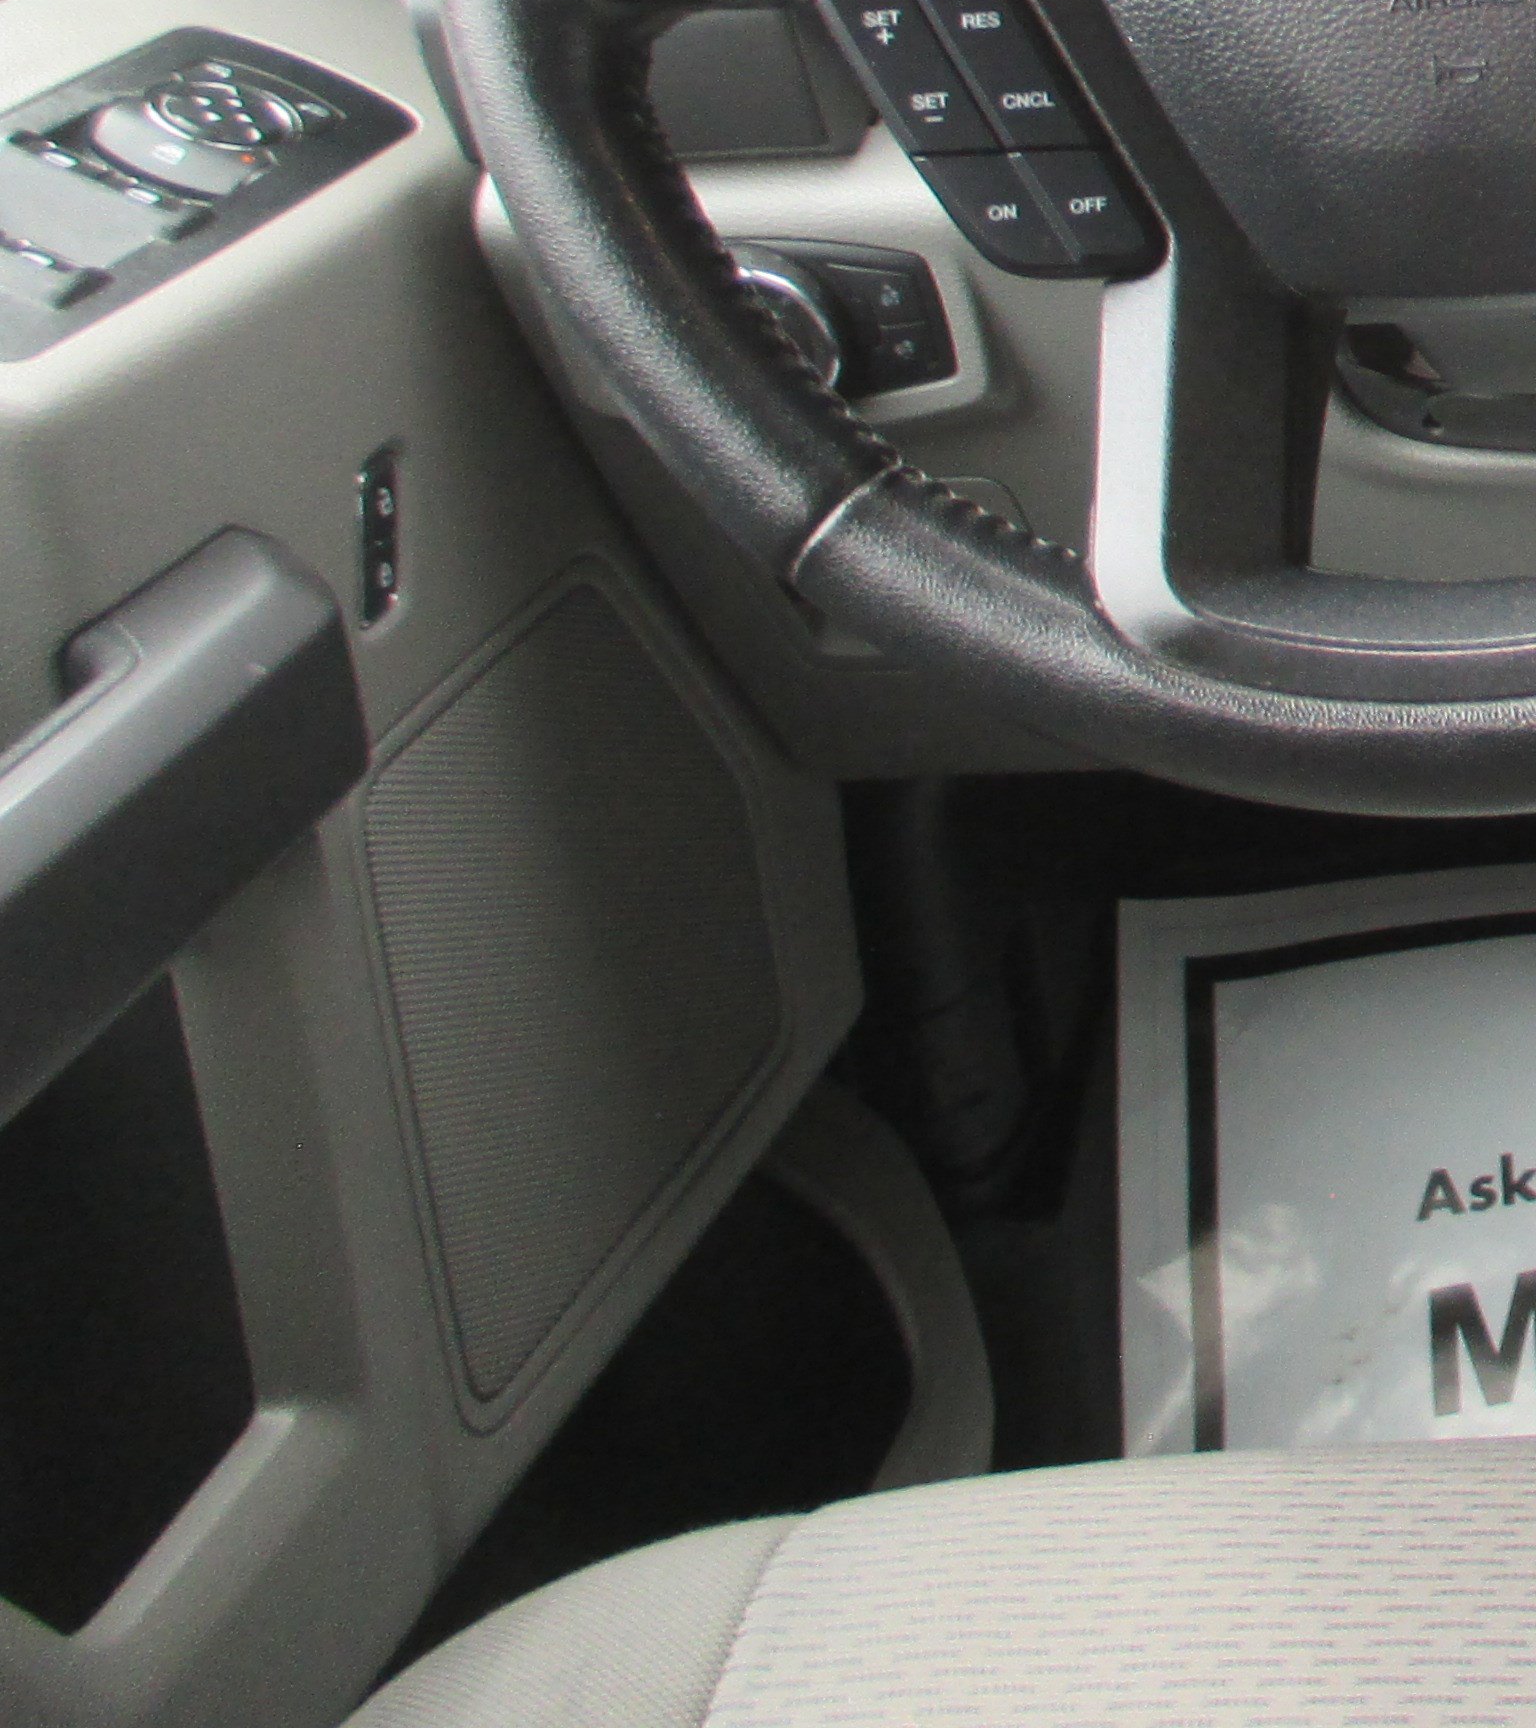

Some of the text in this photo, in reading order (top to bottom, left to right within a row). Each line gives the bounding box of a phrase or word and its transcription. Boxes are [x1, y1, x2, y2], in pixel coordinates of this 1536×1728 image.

[862, 9, 901, 29] SET
[960, 10, 1002, 30] RES
[910, 91, 950, 112] SET
[1002, 91, 1055, 111] CNCL
[987, 203, 1019, 222] ON
[1069, 196, 1108, 215] OFF
